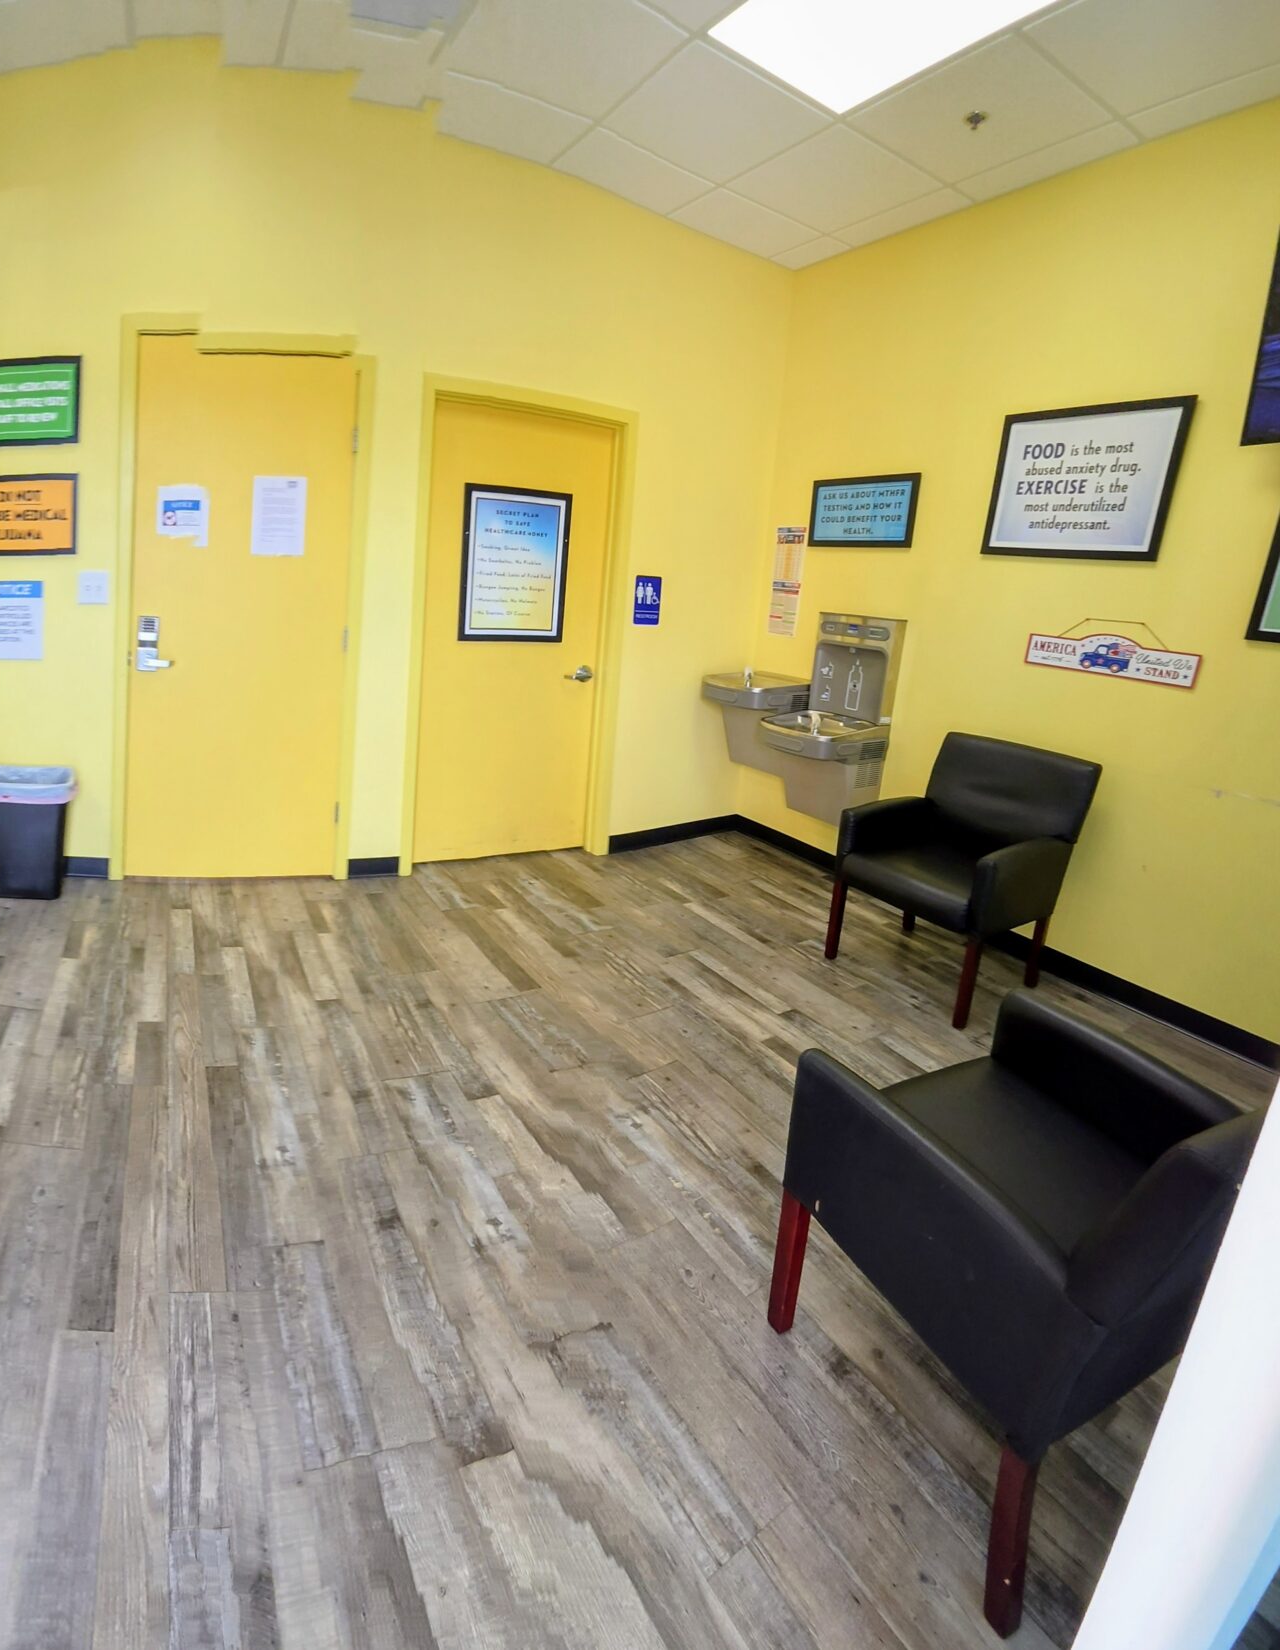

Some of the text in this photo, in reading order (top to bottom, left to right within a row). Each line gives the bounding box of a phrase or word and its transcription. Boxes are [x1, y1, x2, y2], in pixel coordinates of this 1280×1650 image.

[1023, 439, 1134, 460] FOOD is the most
[1025, 457, 1141, 477] abused anxiety drug.
[1015, 477, 1128, 495] EXERCISE is the
[15, 490, 43, 501] NOT
[823, 489, 906, 500] ASK US ABOUT MTHFR
[823, 504, 853, 512] TESTING
[855, 503, 871, 511] AND
[872, 502, 892, 510] HOW
[1024, 496, 1127, 512] most underutilized
[15, 509, 68, 521] MEDICAL
[843, 527, 874, 535] HEALTH.
[1028, 515, 1111, 533] antidepressant.
[485, 528, 526, 536] HEALTHCARE
[1032, 640, 1077, 657] AMERICA
[1134, 653, 1193, 671] United We
[1144, 667, 1180, 680] STAND
